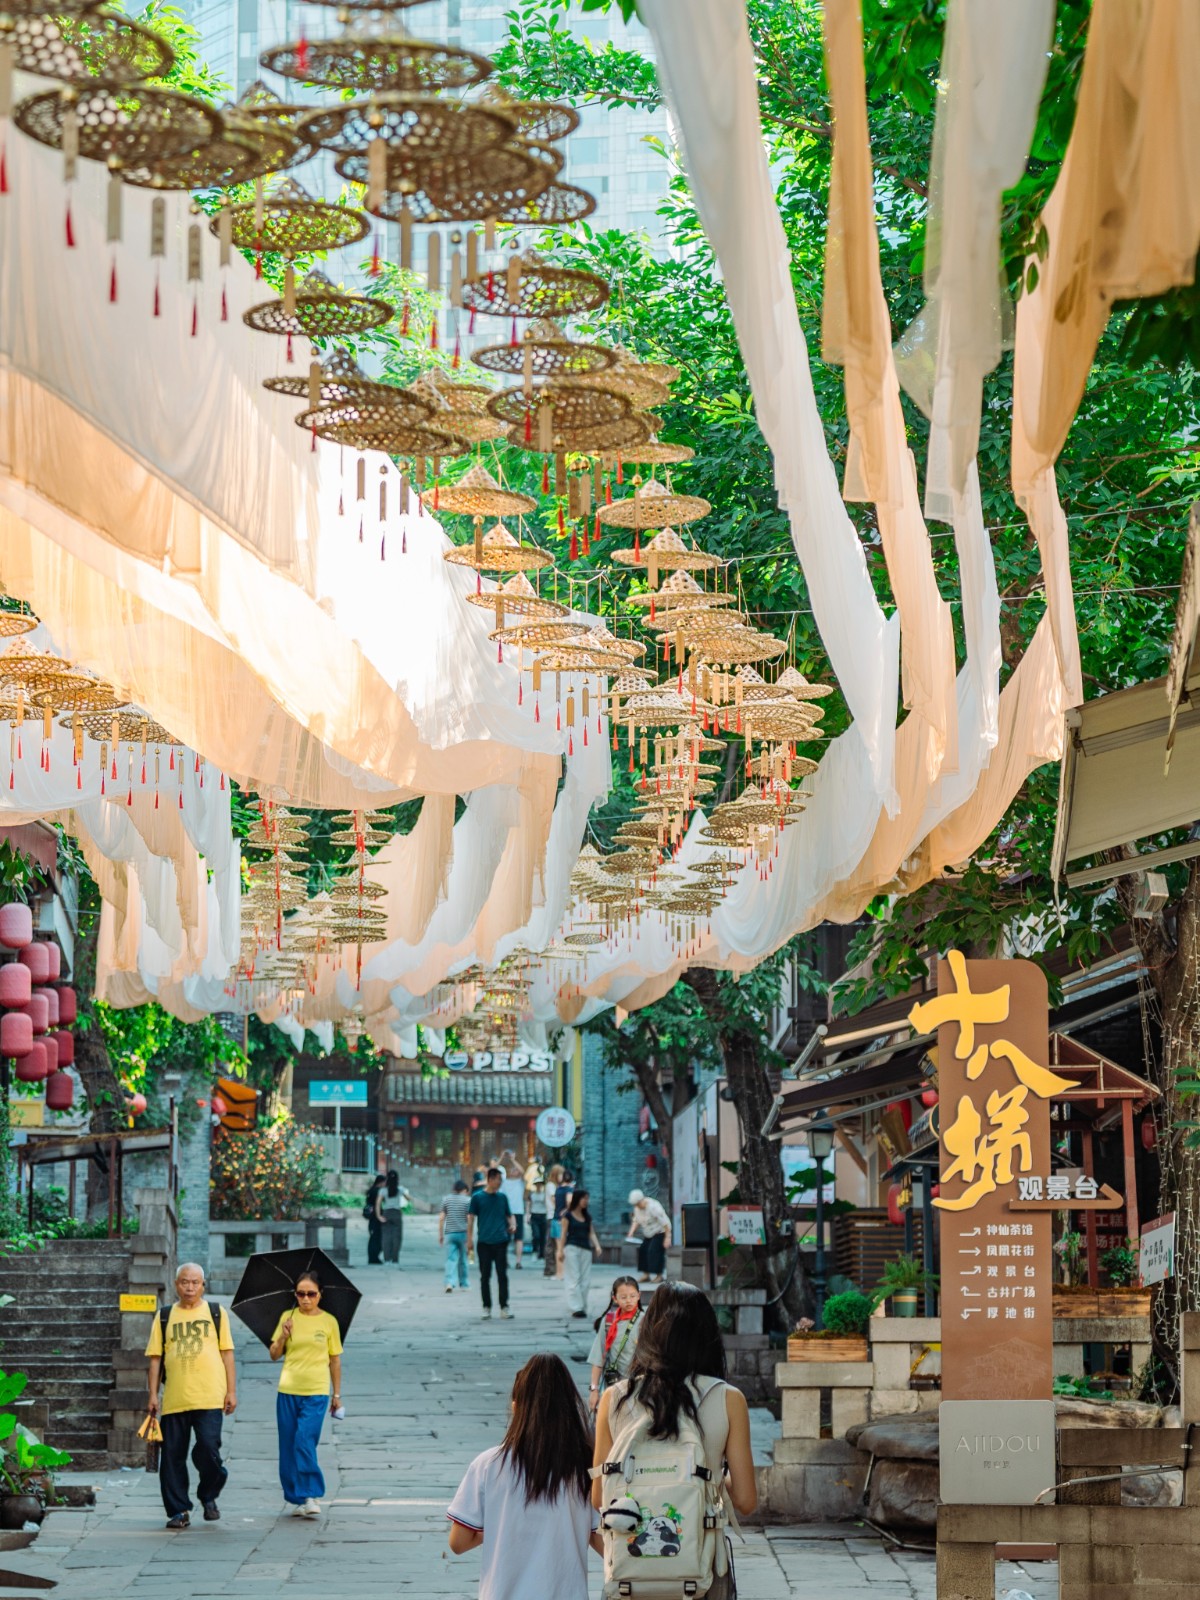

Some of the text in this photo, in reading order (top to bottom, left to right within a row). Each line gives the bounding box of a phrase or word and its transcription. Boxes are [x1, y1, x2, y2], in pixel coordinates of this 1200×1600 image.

[908, 949, 1081, 1211] 十八梯
[1019, 1176, 1100, 1201] 观景台
[987, 1224, 1033, 1236] 神仙茶馆
[987, 1244, 1035, 1256] 凤凰花街
[987, 1265, 1035, 1277] 观景台
[987, 1286, 1036, 1298] 古井广场
[987, 1307, 1035, 1319] 厚池街
[170, 1319, 211, 1343] JUST
[955, 1435, 1041, 1455] AJIDOU
